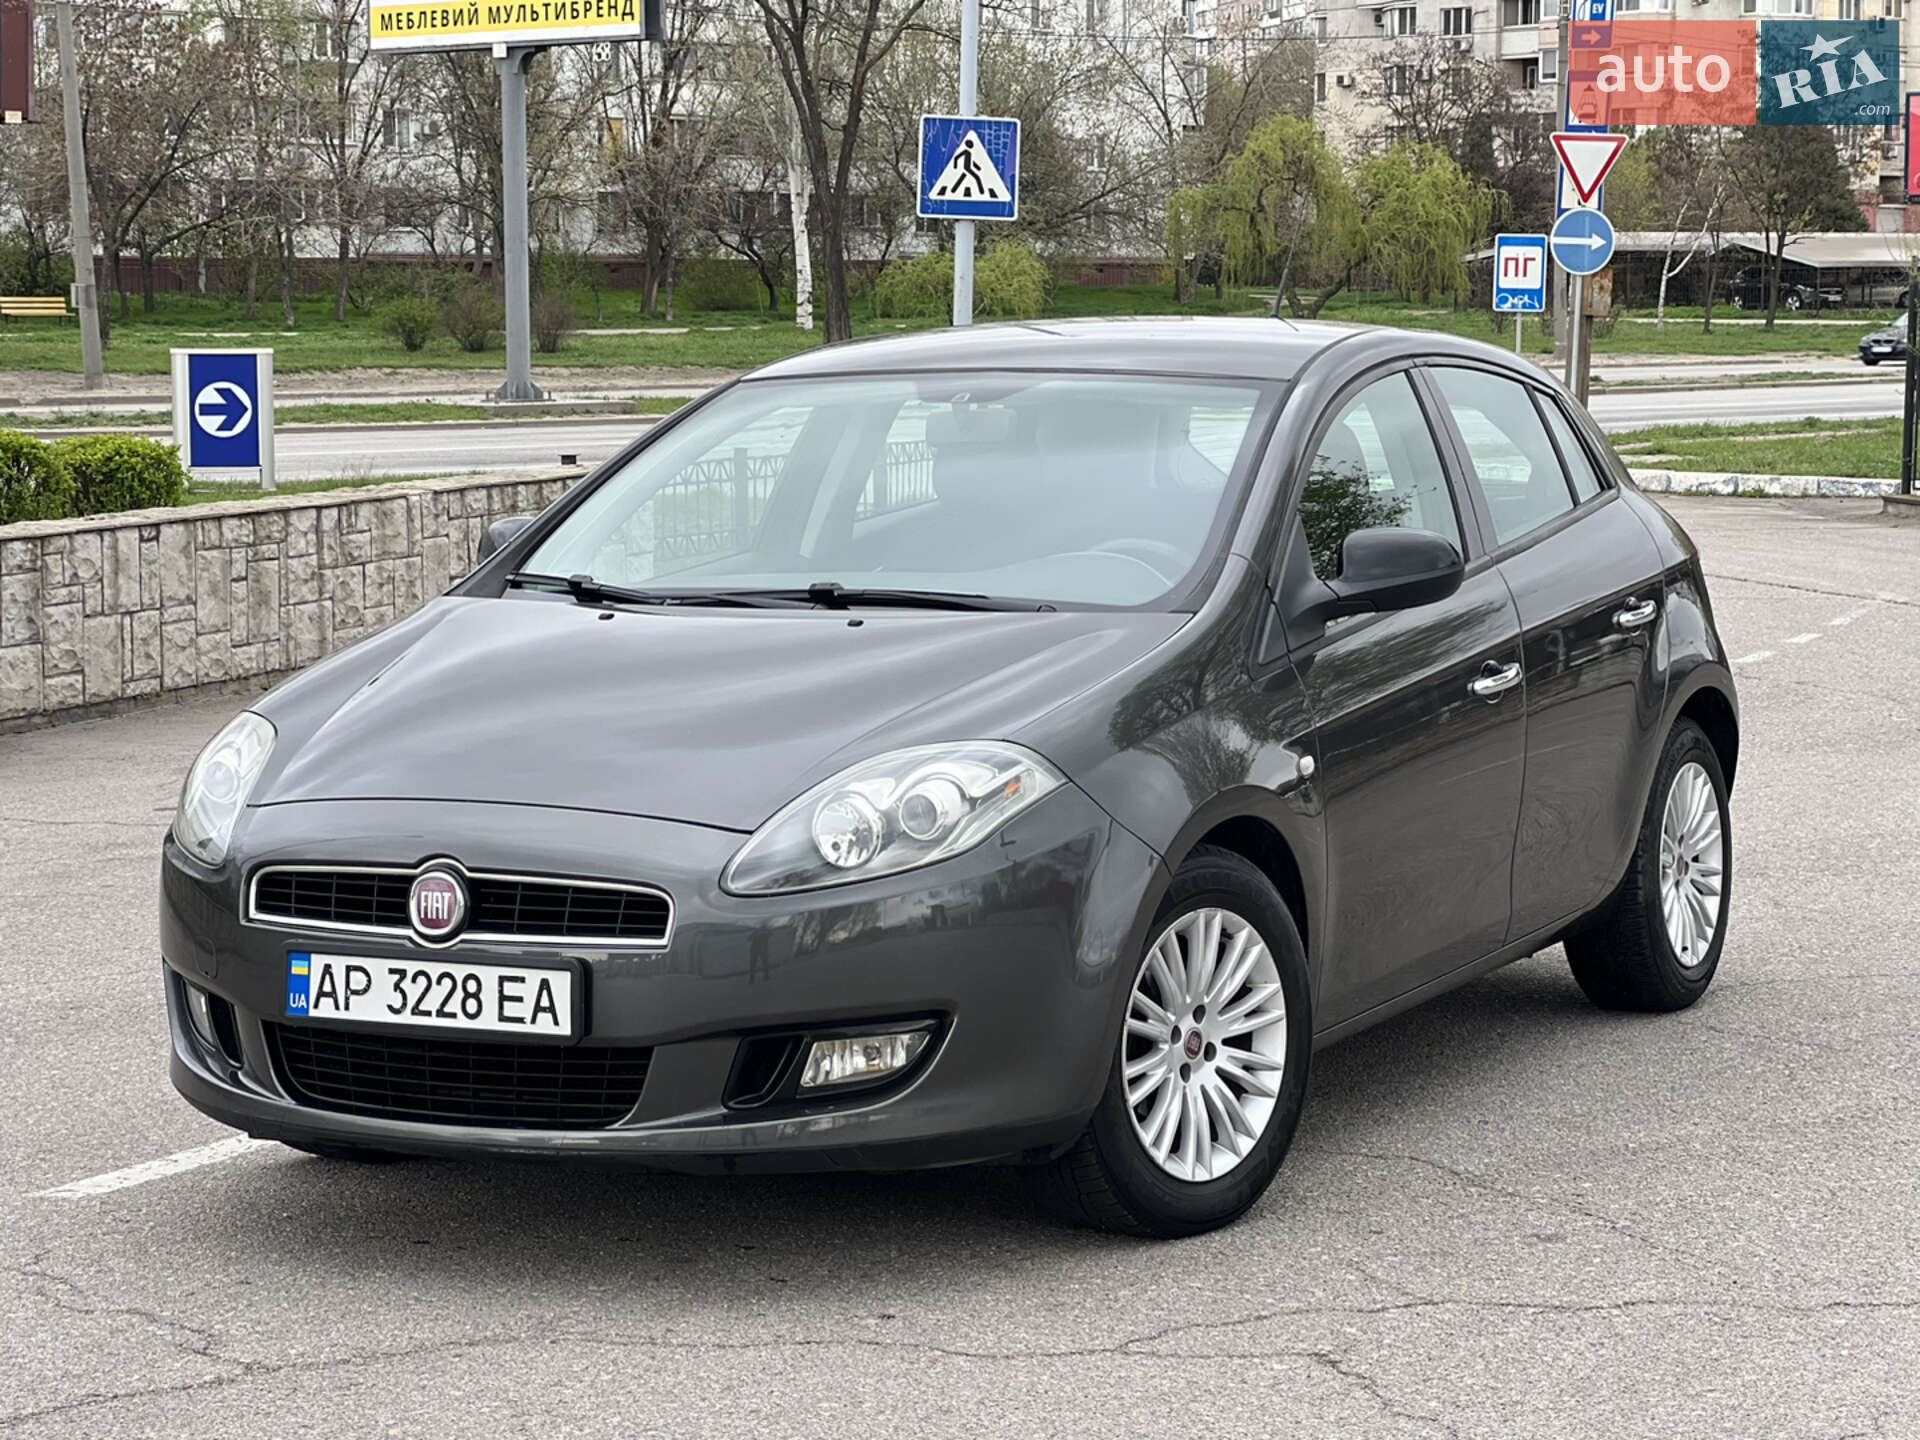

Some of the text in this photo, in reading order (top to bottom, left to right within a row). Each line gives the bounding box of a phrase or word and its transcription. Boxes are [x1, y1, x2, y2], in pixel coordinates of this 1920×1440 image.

[380, 0, 635, 31] МЕБЛЕВИЙ МУЛЬТИБРЕНД
[1592, 3, 1605, 14] EV
[1503, 257, 1537, 278] ПГ
[420, 890, 451, 920] FIAT
[289, 993, 308, 1009] UA
[386, 968, 483, 1021] 3228
